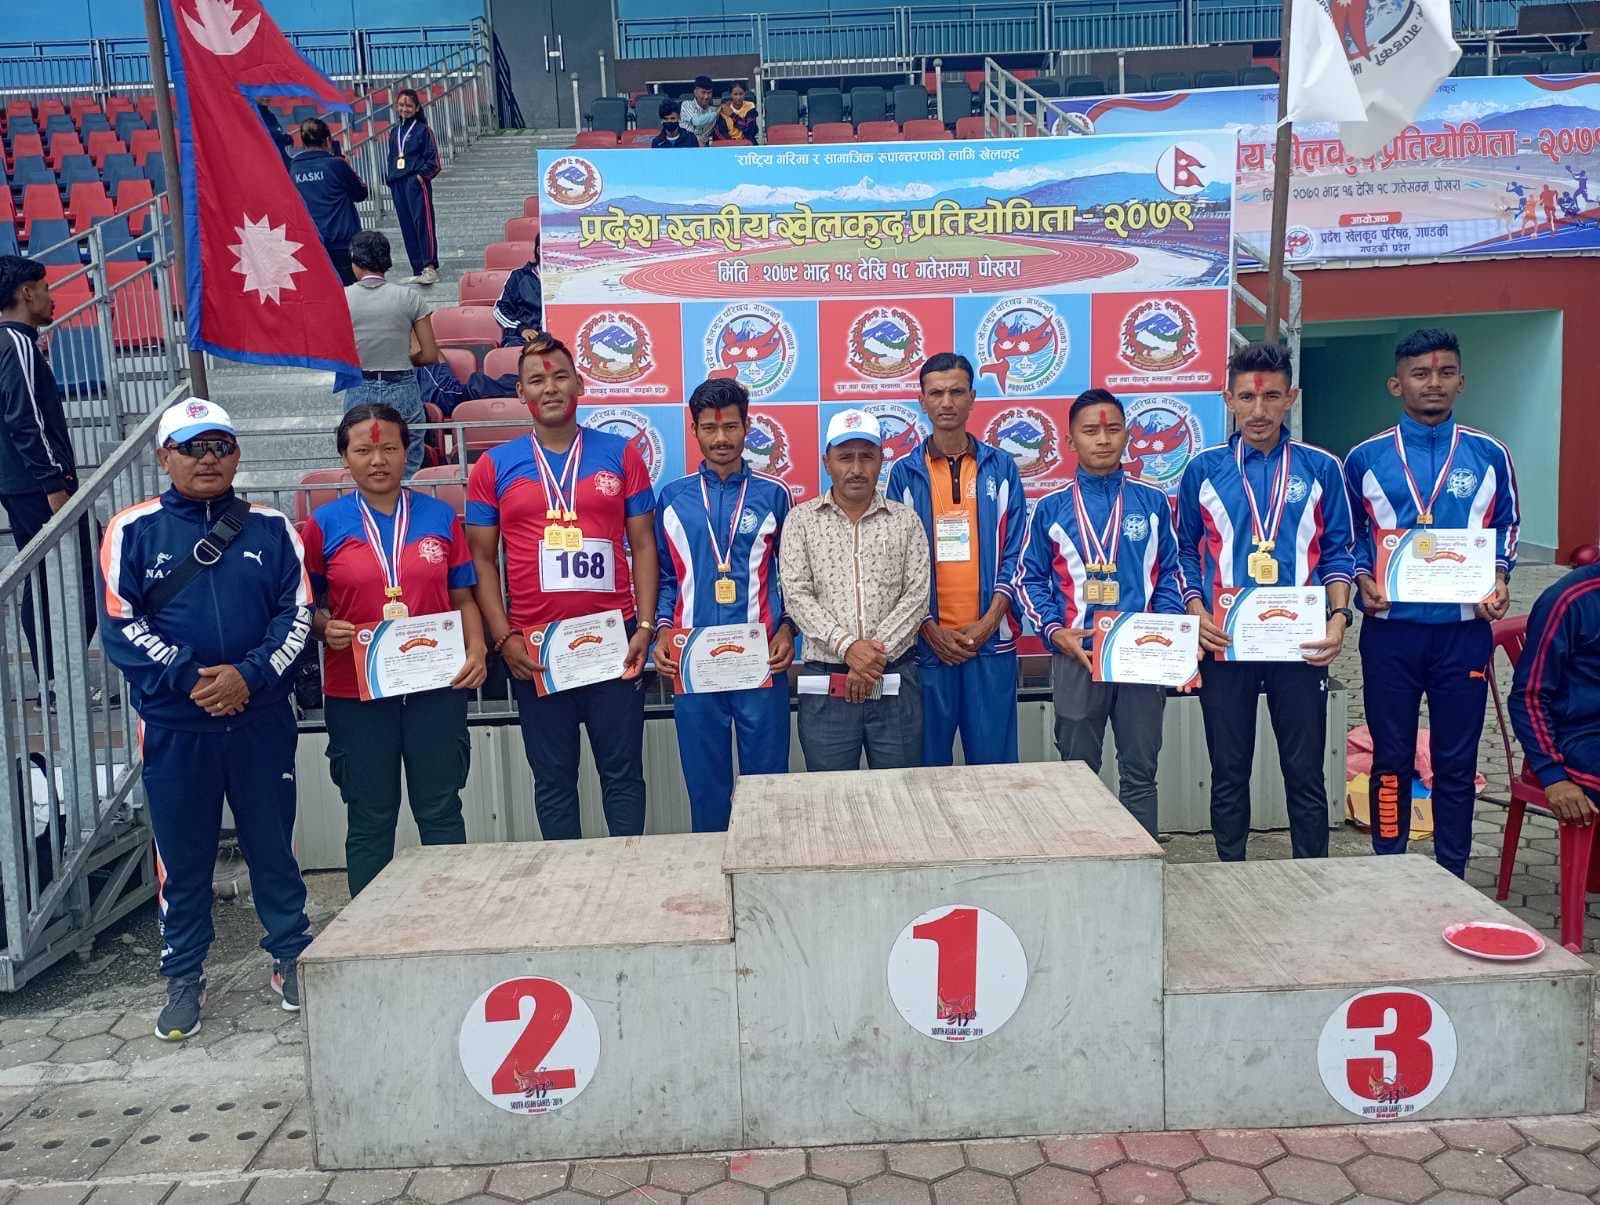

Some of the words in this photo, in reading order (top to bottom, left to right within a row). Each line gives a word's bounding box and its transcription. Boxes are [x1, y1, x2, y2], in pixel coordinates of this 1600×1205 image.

[777, 151, 809, 165] गरिमा
[813, 154, 820, 165] र
[824, 149, 873, 164] सामाजिक
[949, 147, 975, 160] लागि
[295, 171, 324, 183] KASKI
[1434, 177, 1462, 192] पोखरा
[579, 203, 660, 248] प्रदेश
[666, 202, 771, 250] स्तरीय
[776, 202, 907, 248] खेलकुद
[910, 198, 1076, 243] प्रतियोगिता
[1103, 200, 1195, 238] २०७९
[1320, 230, 1341, 244] प्रदेश
[1345, 229, 1377, 243] खेलकुद
[1416, 224, 1448, 238] गण्डकी
[718, 260, 749, 282] मिति
[762, 263, 798, 282] २०७९
[803, 263, 830, 283] भाद्र
[835, 262, 852, 281] १६
[858, 257, 887, 280] देखि
[893, 261, 909, 279] १८
[978, 255, 1022, 277] पोखरा
[556, 552, 605, 579] 168
[913, 909, 978, 1019] 1
[485, 977, 576, 1095] 2
[1346, 992, 1433, 1101] 3
